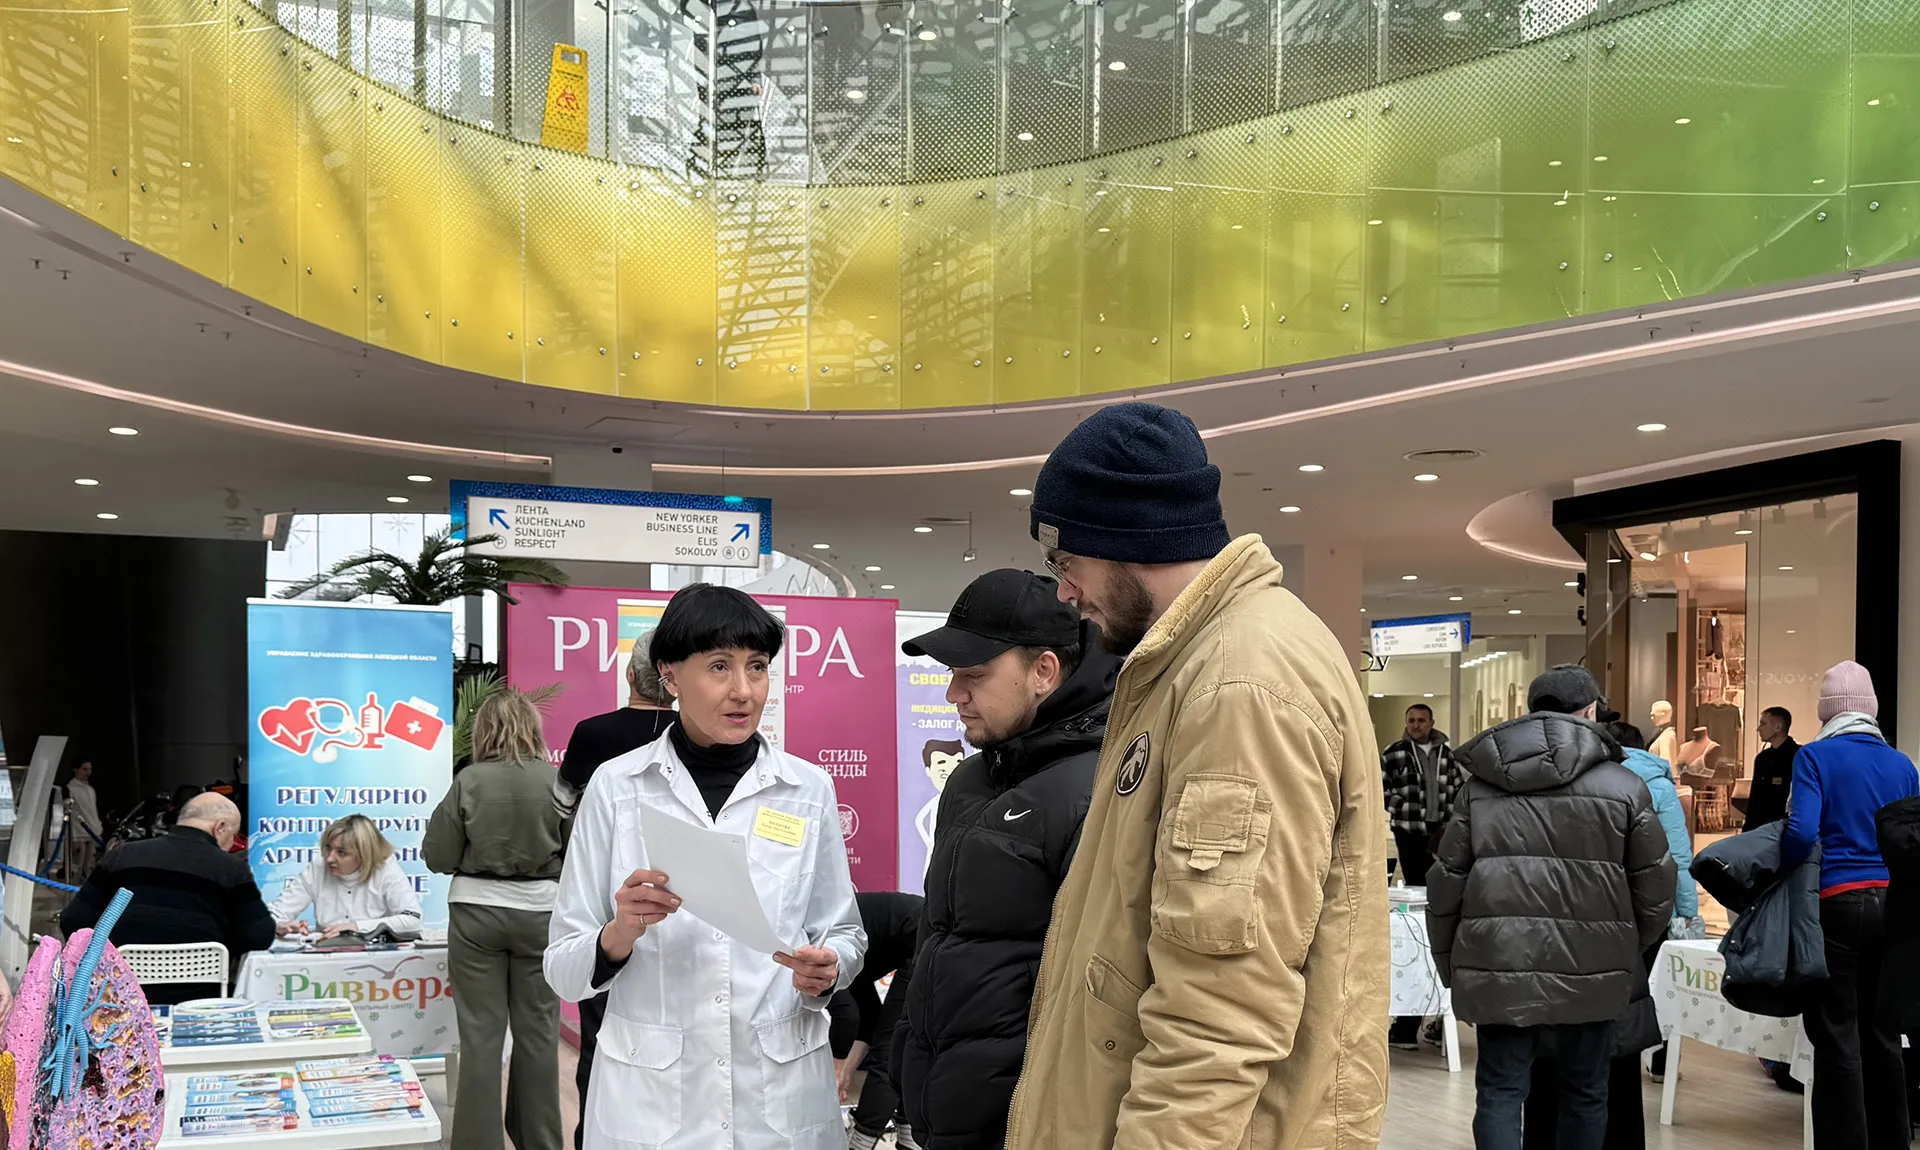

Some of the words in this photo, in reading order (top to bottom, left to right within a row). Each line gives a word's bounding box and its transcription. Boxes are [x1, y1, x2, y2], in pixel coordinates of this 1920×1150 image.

[515, 505, 549, 515] ЛЕНТА
[515, 516, 586, 528] KUCHENLAND
[656, 513, 678, 522] NEW
[681, 514, 718, 524] YORKER
[515, 527, 566, 538] SUNLIGHT
[646, 522, 694, 533] BUSINESS
[696, 526, 718, 535] LINE
[514, 538, 556, 549] RESPECT
[697, 537, 718, 546] ELIS
[675, 547, 718, 557] SOKOLOV
[918, 719, 955, 729] ЗАЛОГ
[818, 749, 868, 762] СТИЛЬ
[277, 788, 428, 806] РЕГУЛЯРНО
